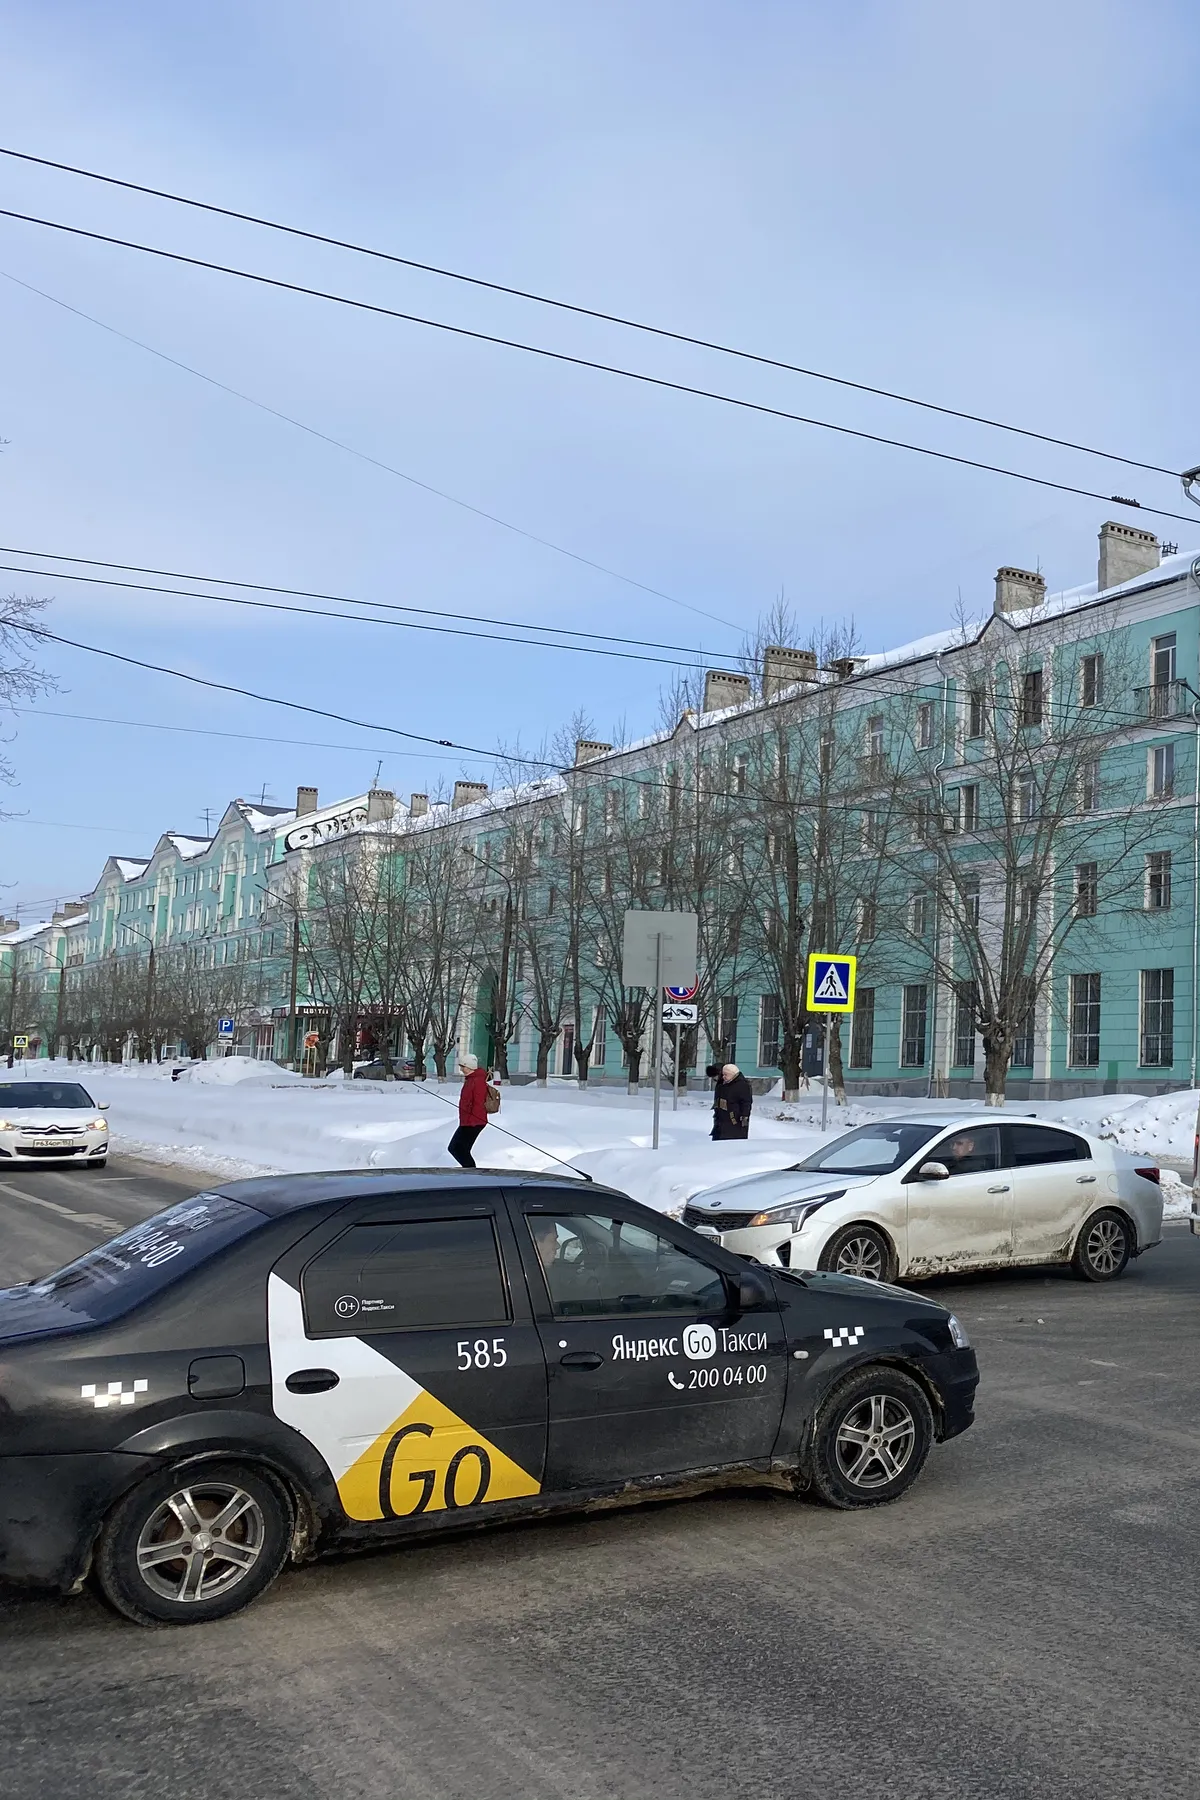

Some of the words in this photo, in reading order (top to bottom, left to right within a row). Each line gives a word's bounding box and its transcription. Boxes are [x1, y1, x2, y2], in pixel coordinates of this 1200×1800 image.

[457, 1338, 507, 1371] 585
[612, 1335, 679, 1361] Яндекс
[687, 1330, 712, 1354] Go
[718, 1327, 768, 1352] Такси
[688, 1368, 720, 1389] 200
[722, 1366, 744, 1386] 04
[746, 1364, 768, 1384] 00
[378, 1422, 492, 1518] Go
